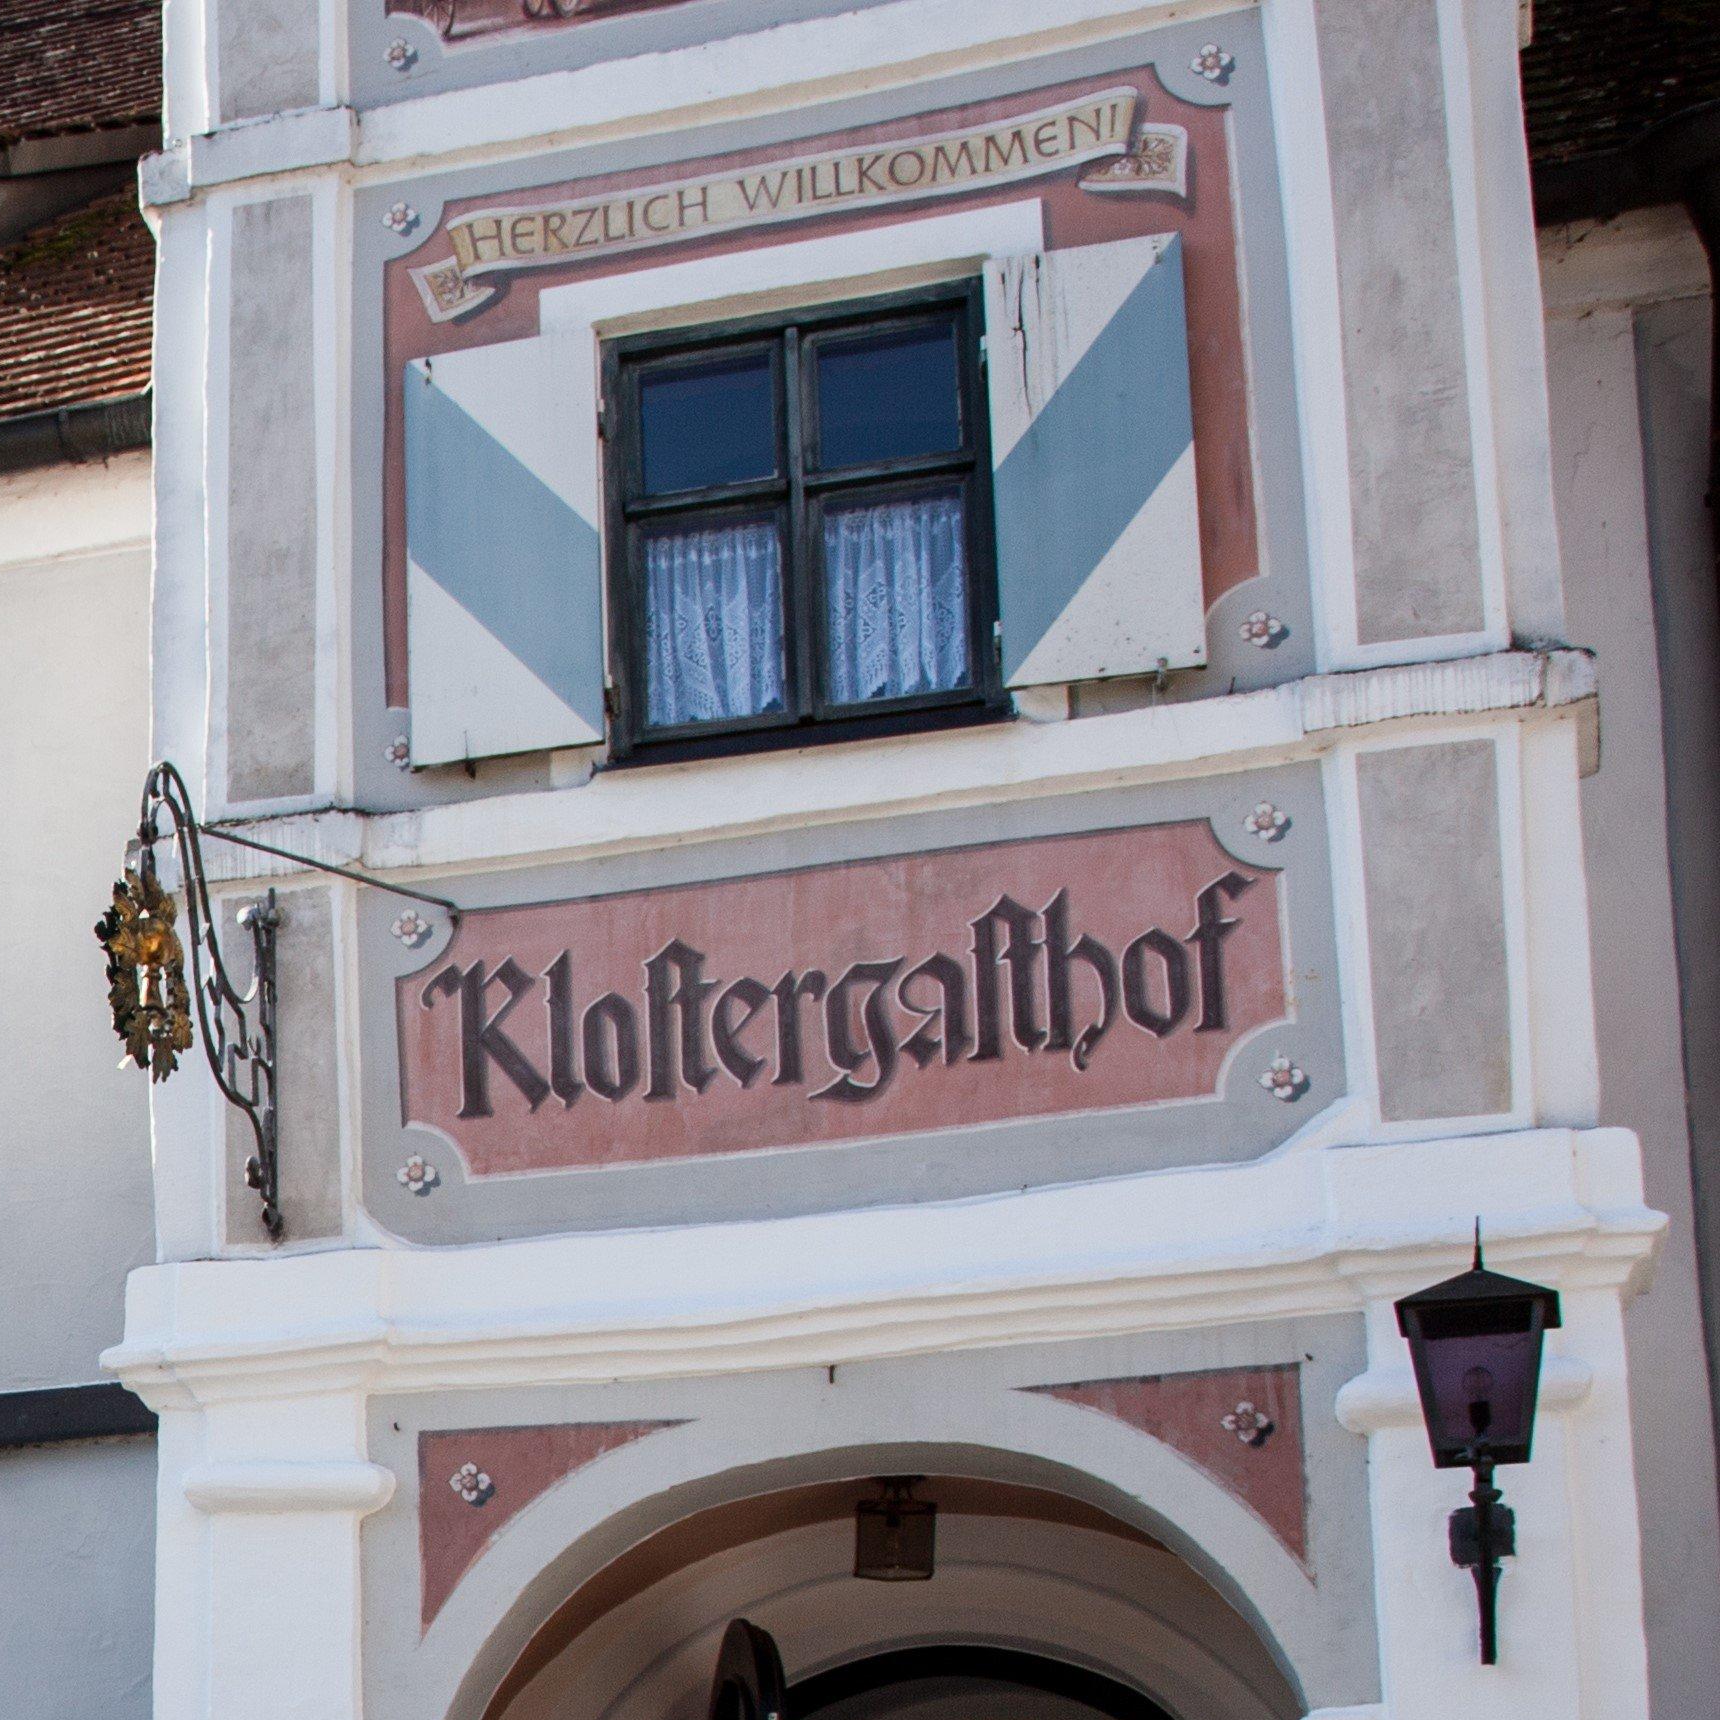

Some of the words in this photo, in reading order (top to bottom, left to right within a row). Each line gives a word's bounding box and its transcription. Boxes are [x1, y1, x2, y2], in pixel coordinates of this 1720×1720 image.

[465, 185, 709, 261] HERZLICH
[736, 102, 1121, 213] WILLKOMMEN!
[420, 869, 1261, 1120] Klostergasthof
